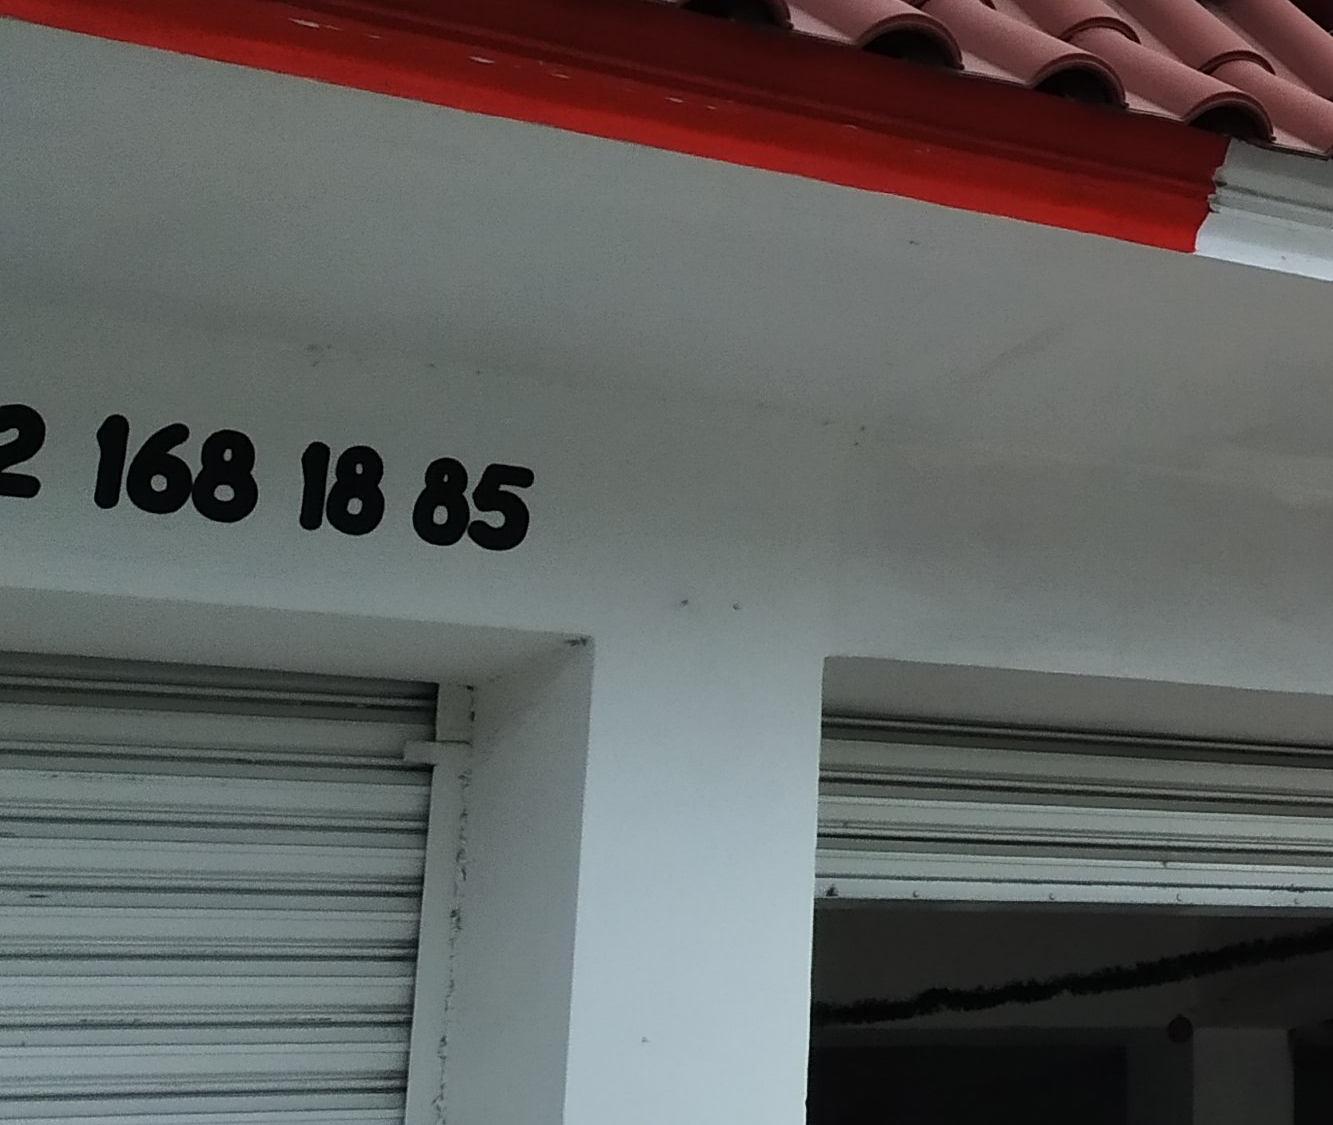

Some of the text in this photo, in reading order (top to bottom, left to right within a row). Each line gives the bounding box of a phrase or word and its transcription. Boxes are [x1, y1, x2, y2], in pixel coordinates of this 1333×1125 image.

[93, 414, 259, 524] 168
[300, 441, 386, 536] 18
[411, 457, 535, 551] 85
